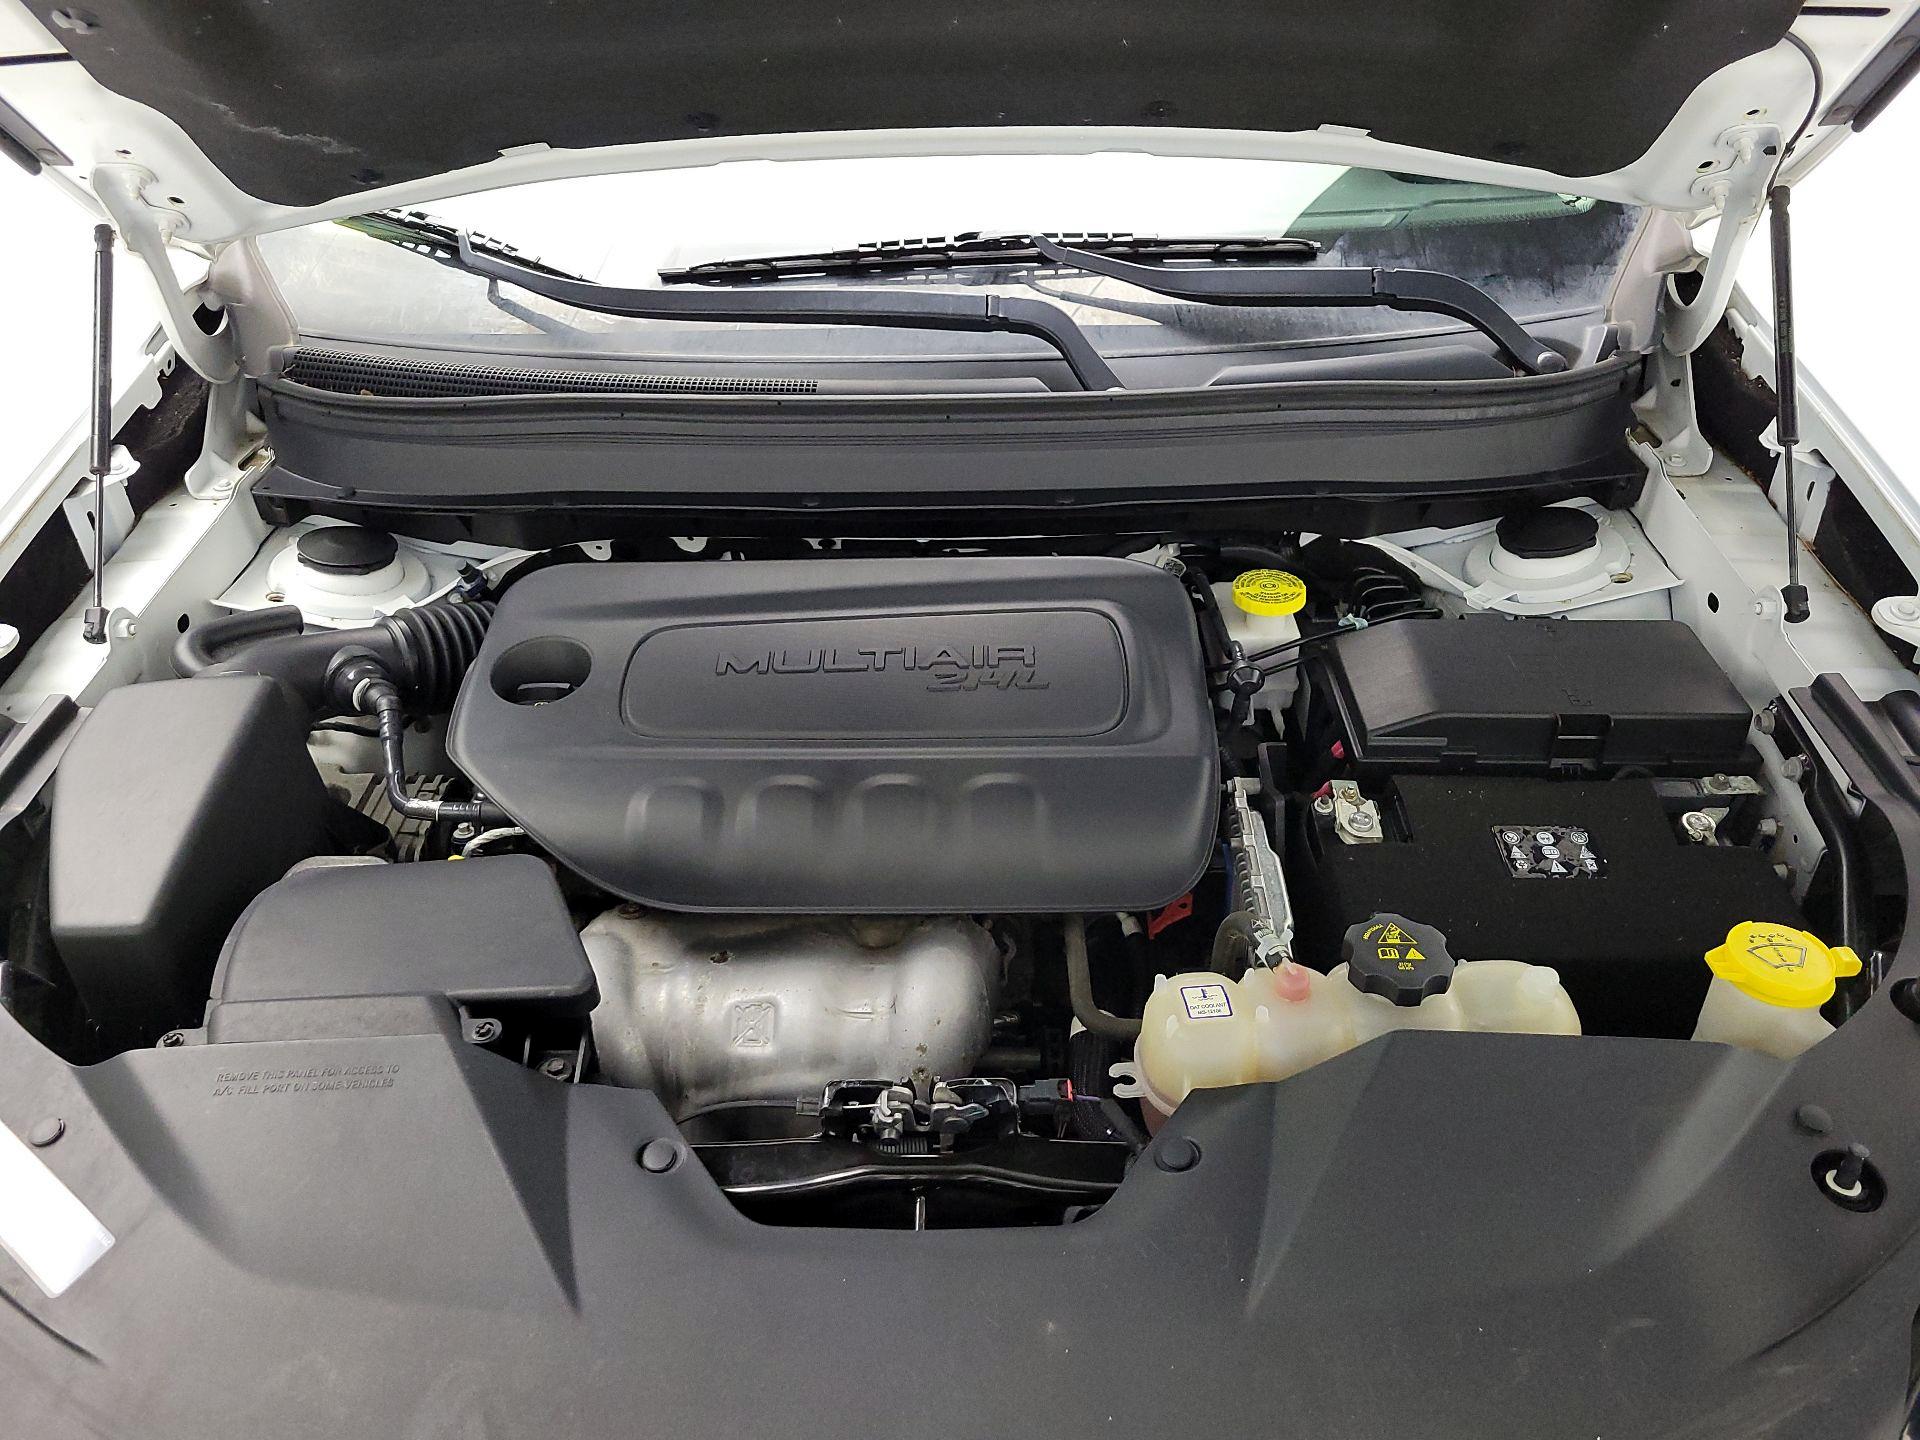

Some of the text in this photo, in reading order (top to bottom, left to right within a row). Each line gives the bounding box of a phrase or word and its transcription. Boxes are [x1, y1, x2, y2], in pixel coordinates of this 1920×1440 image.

[714, 644, 1036, 676] MULTIAIR
[217, 1064, 400, 1082] REMOVE THIS PANEL FOR ACCESS TO
[238, 1085, 259, 1095] FILL
[262, 1083, 290, 1094] PORT
[345, 1078, 394, 1090] VEHICLES
